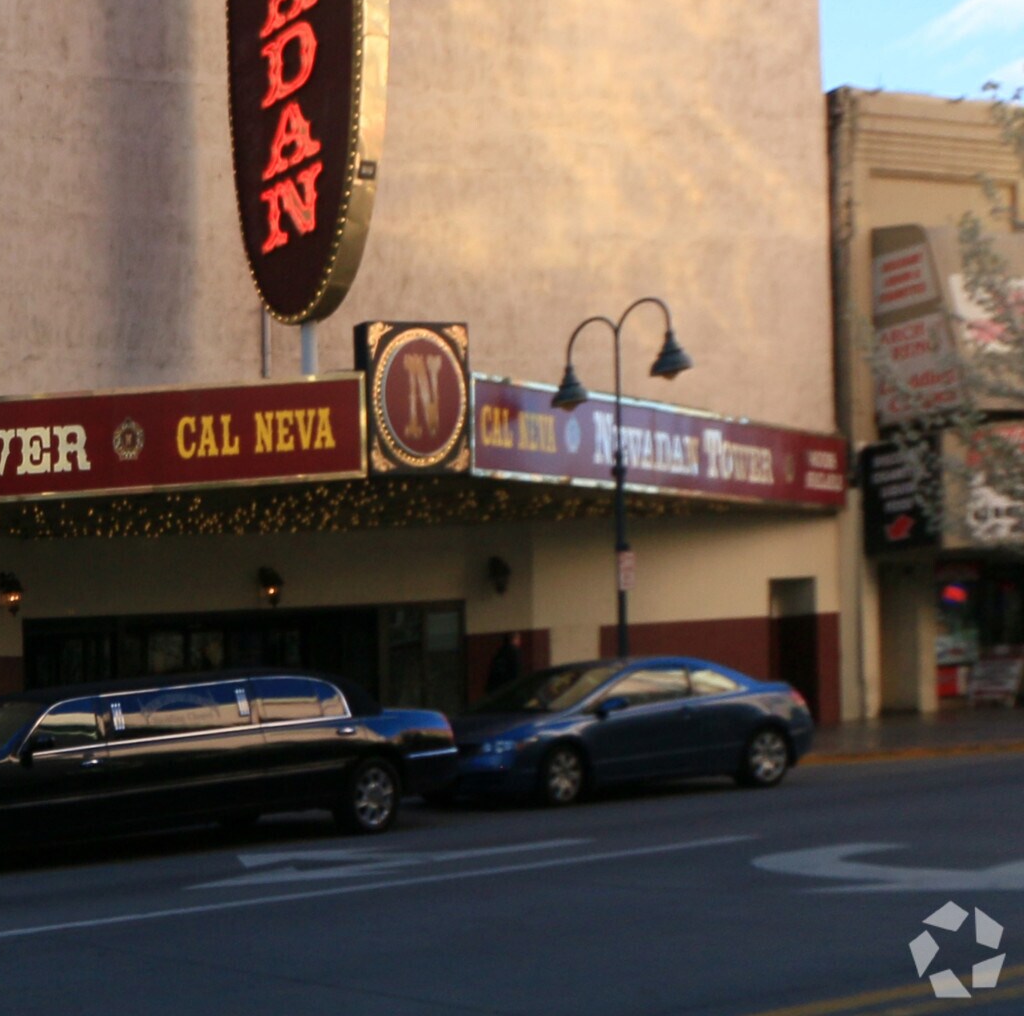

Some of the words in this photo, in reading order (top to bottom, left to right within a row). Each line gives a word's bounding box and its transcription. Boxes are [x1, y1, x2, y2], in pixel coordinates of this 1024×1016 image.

[403, 352, 443, 440] N
[177, 415, 239, 460] CAL
[254, 407, 336, 455] NEVA
[480, 404, 514, 448] CAL
[703, 429, 774, 485] TOWER
